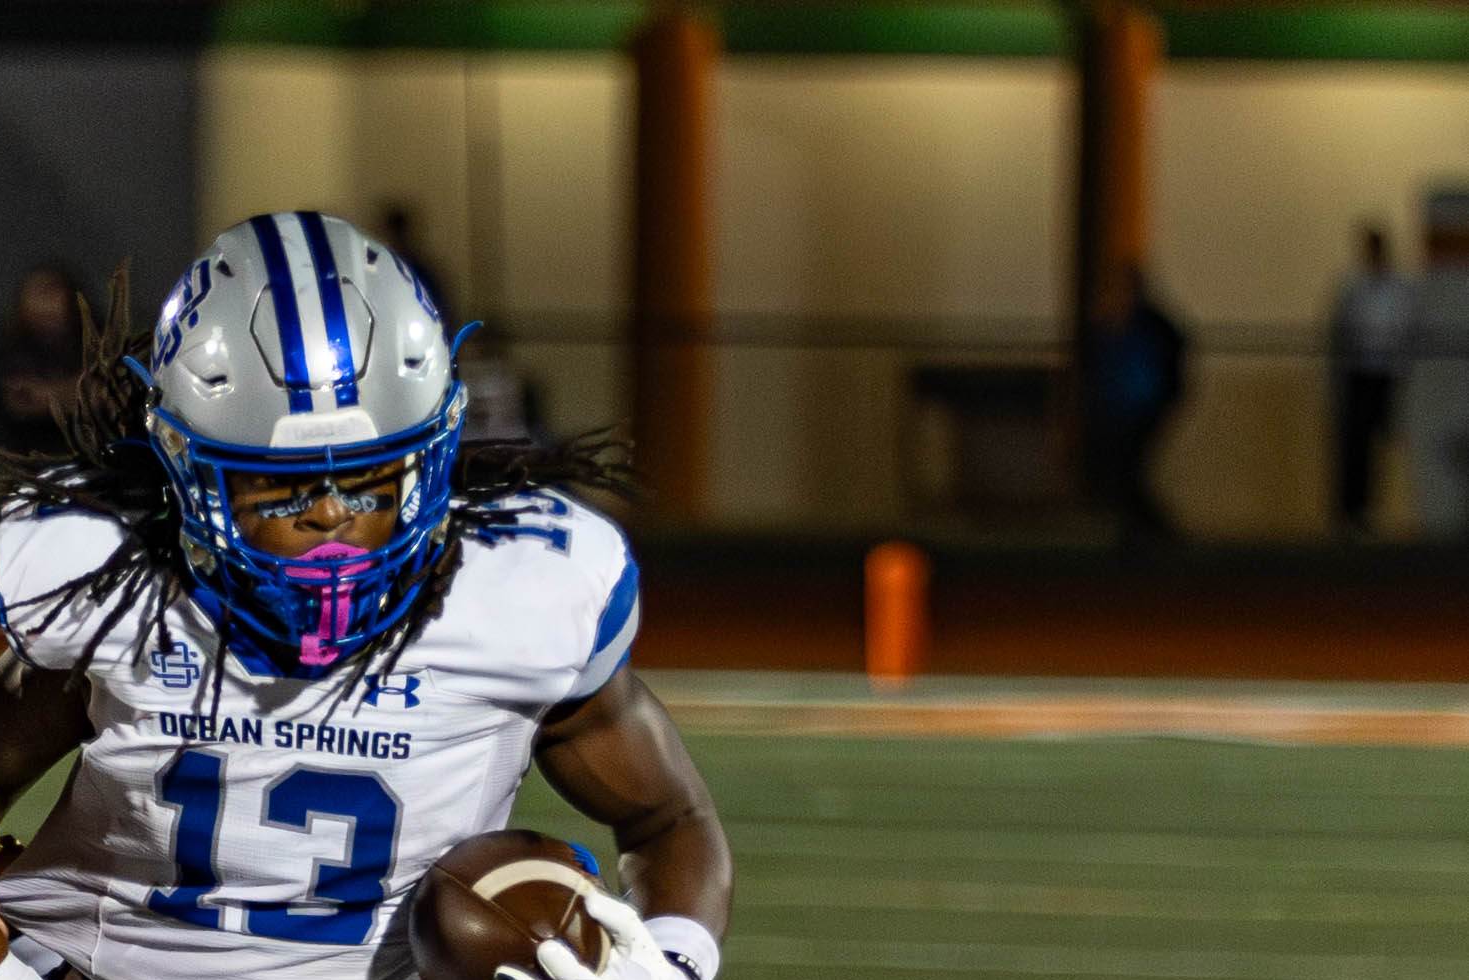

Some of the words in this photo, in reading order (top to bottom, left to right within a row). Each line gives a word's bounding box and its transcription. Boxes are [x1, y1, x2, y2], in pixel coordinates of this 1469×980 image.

[159, 711, 263, 746] OCEAN
[274, 720, 412, 760] SPRINGS
[143, 748, 405, 945] 13
